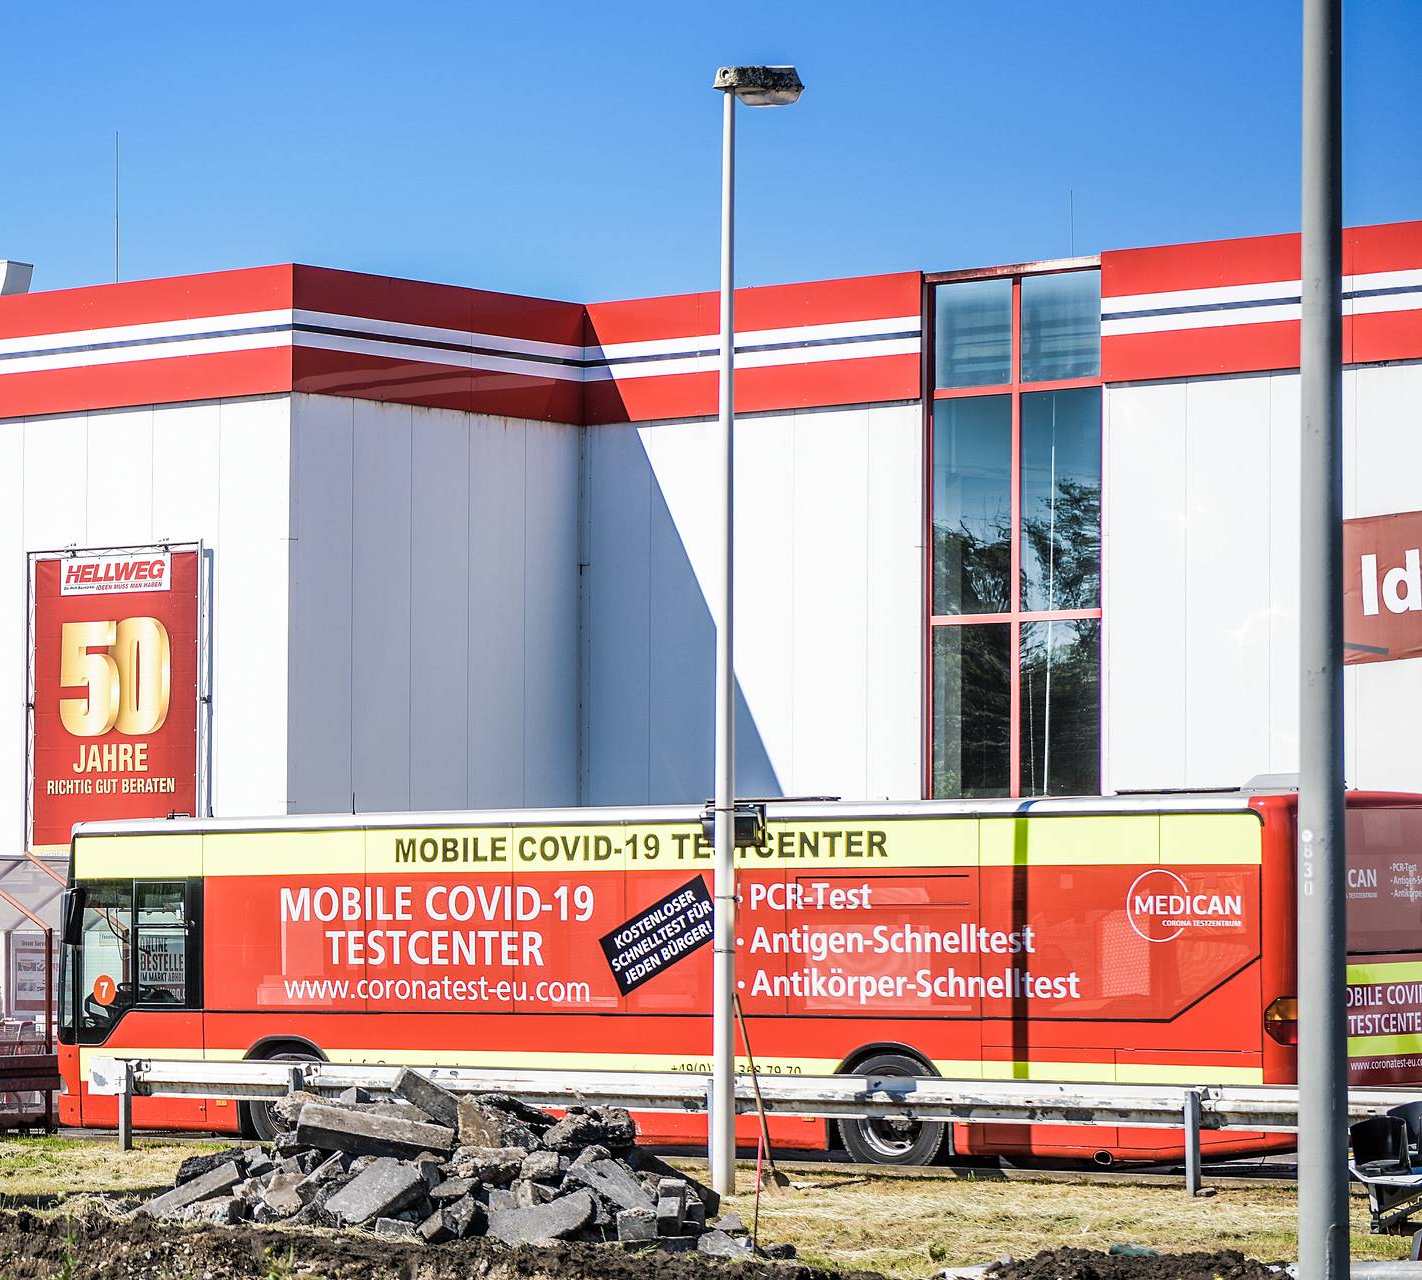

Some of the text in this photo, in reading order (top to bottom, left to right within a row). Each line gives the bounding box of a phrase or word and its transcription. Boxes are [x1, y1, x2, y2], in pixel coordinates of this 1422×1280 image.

[65, 560, 166, 583] HELLWEG
[1361, 548, 1422, 616] Id
[59, 617, 171, 737] 50
[73, 743, 148, 773] JAHRE
[47, 778, 175, 795] RICHTIG GUT BERATEN
[394, 830, 888, 863] MOBILE COVID-19 TECENTER
[1347, 868, 1377, 888] CAN
[280, 885, 594, 922] MOBILE COVID-19
[750, 883, 872, 910] PCR-Test
[1135, 895, 1242, 915] MEDICAN
[614, 890, 696, 950] KOSTENLOSER
[325, 930, 544, 966] TESTCENTER
[610, 900, 713, 972] SCHNELLTEST FÜR
[750, 924, 1035, 961] Antigen-Schnelltest
[141, 953, 184, 971] BESTELLE
[625, 920, 713, 985] JEDEN BÜRGER!
[99, 981, 109, 999] 7
[284, 976, 590, 1003] www.coronatest-eu.com
[751, 968, 1081, 1005] Antikörper-Schnelltest
[1346, 986, 1383, 1007] OBILE
[1348, 1012, 1422, 1034] TESTCENTE
